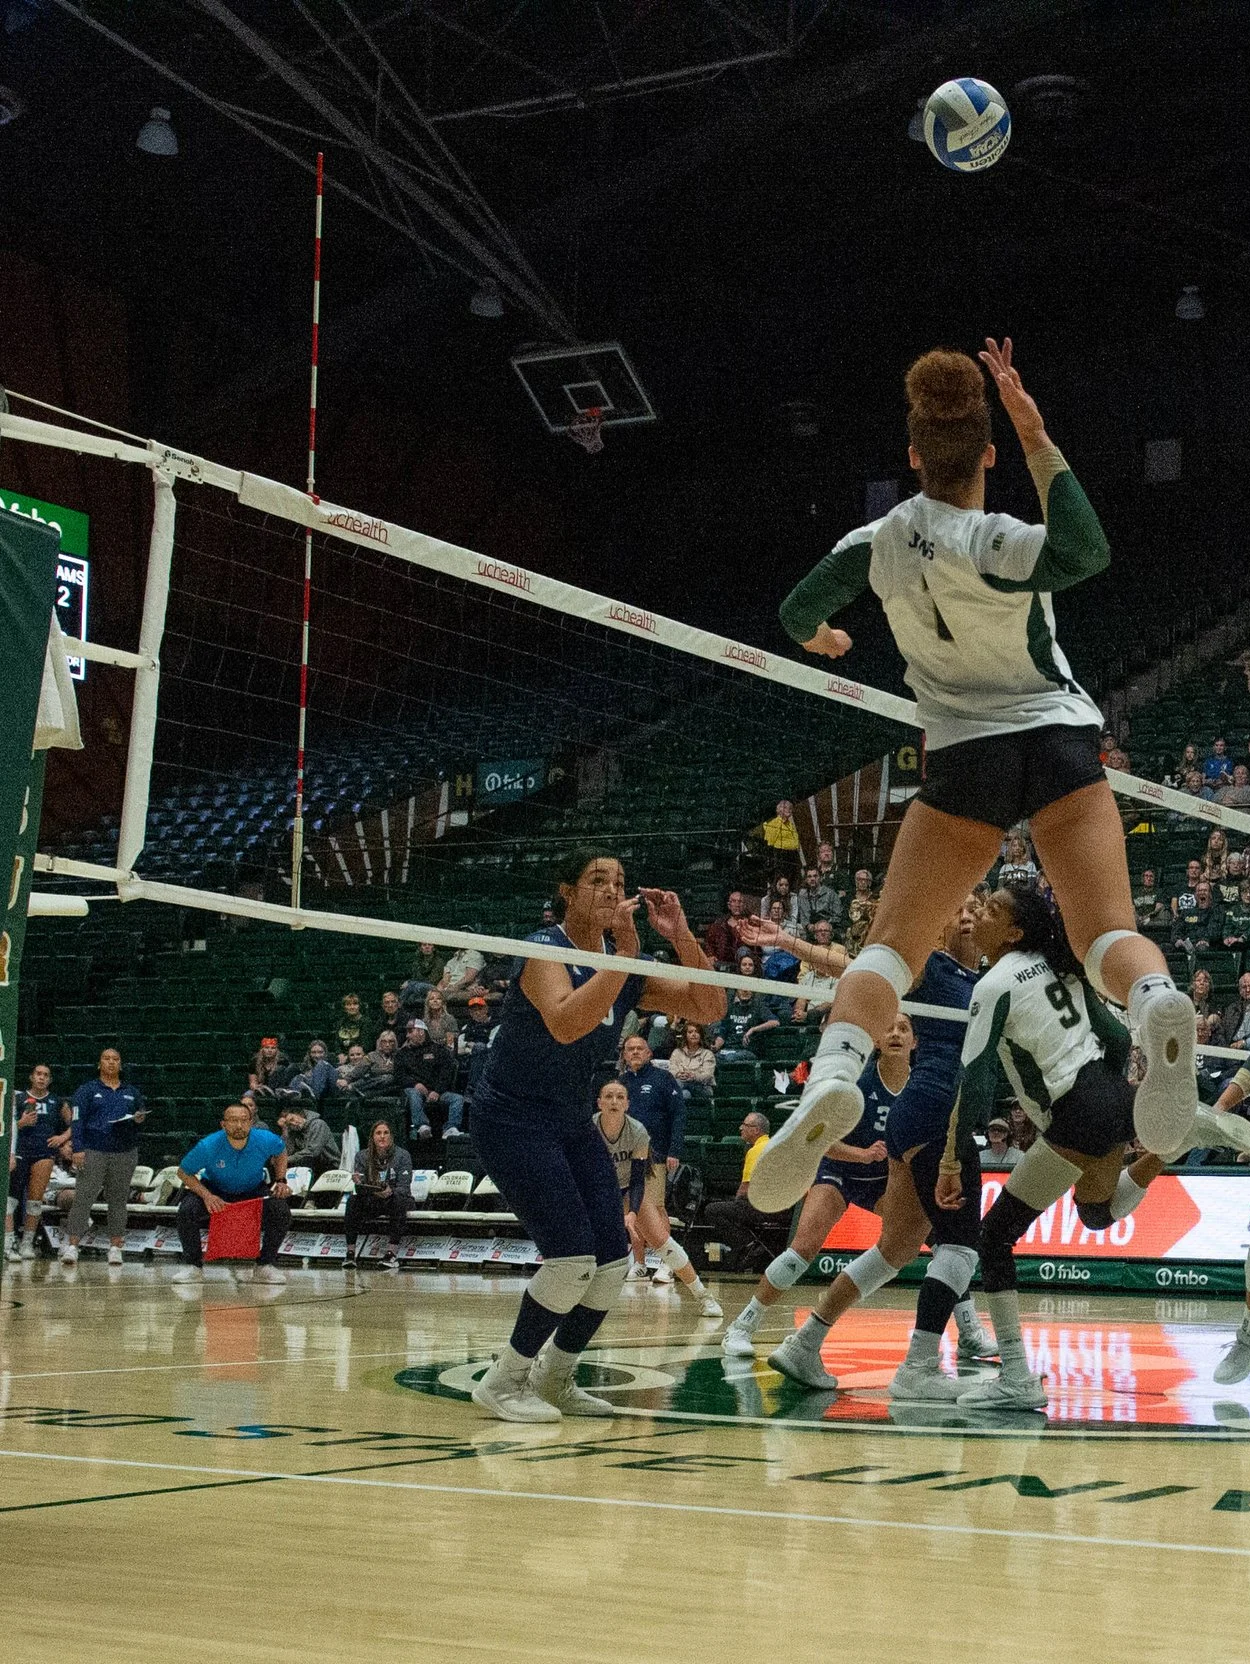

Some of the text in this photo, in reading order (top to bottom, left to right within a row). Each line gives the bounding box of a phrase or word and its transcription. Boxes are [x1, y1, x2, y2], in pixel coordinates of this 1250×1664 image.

[328, 510, 388, 543] uchealth
[478, 560, 531, 592] uchealth
[609, 604, 656, 633] uchealth
[725, 643, 767, 670] uchealth
[827, 677, 865, 701] uchealth
[897, 746, 918, 771] G
[1044, 981, 1081, 1030] 9
[873, 1105, 891, 1132] 3
[1058, 1263, 1091, 1280] fnbo
[1173, 1267, 1209, 1286] fnbo
